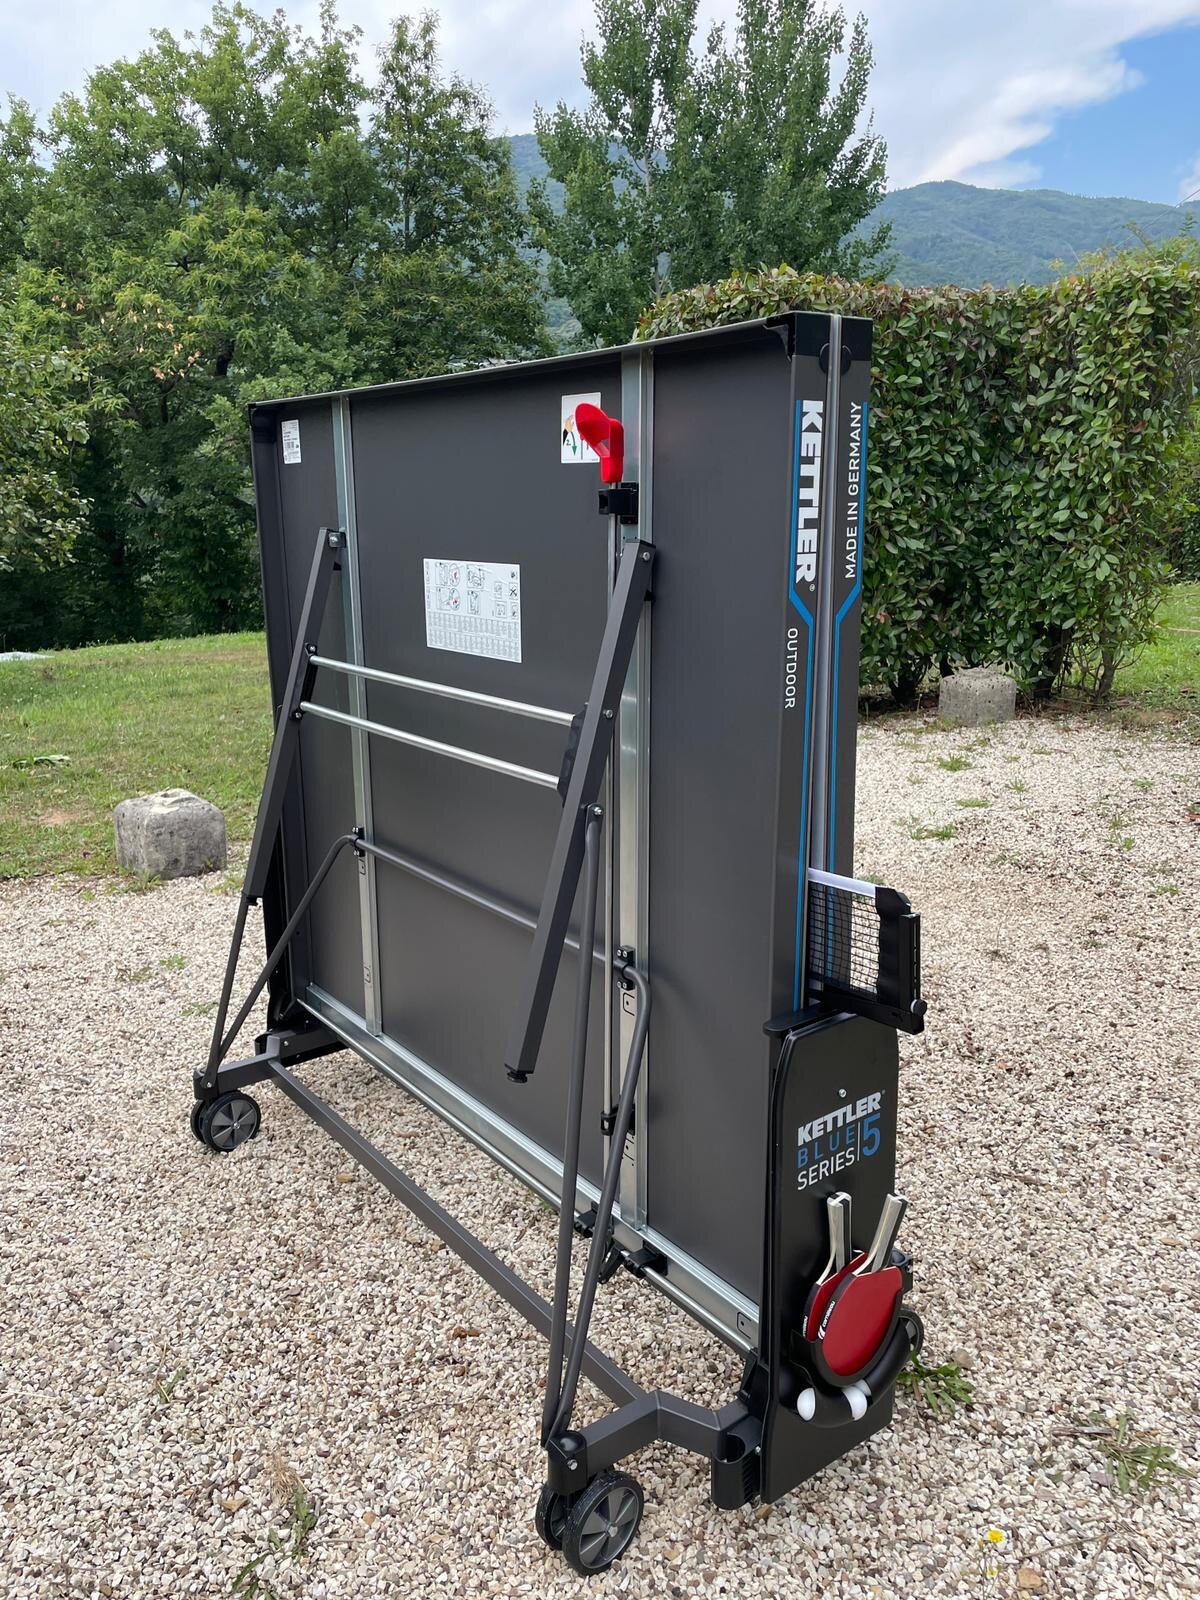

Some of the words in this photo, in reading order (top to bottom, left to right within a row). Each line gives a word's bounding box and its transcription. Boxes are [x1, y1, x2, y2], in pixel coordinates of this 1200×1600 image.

[847, 401, 862, 496] GERMANY
[795, 400, 824, 584] KETTLER
[846, 502, 859, 520] IN
[844, 525, 857, 578] MADE
[784, 628, 799, 709] OUTDOOR
[797, 1091, 882, 1147] KETTLER
[797, 1122, 856, 1169] BLUE
[862, 1112, 881, 1157] 5
[797, 1146, 855, 1191] SERIES
